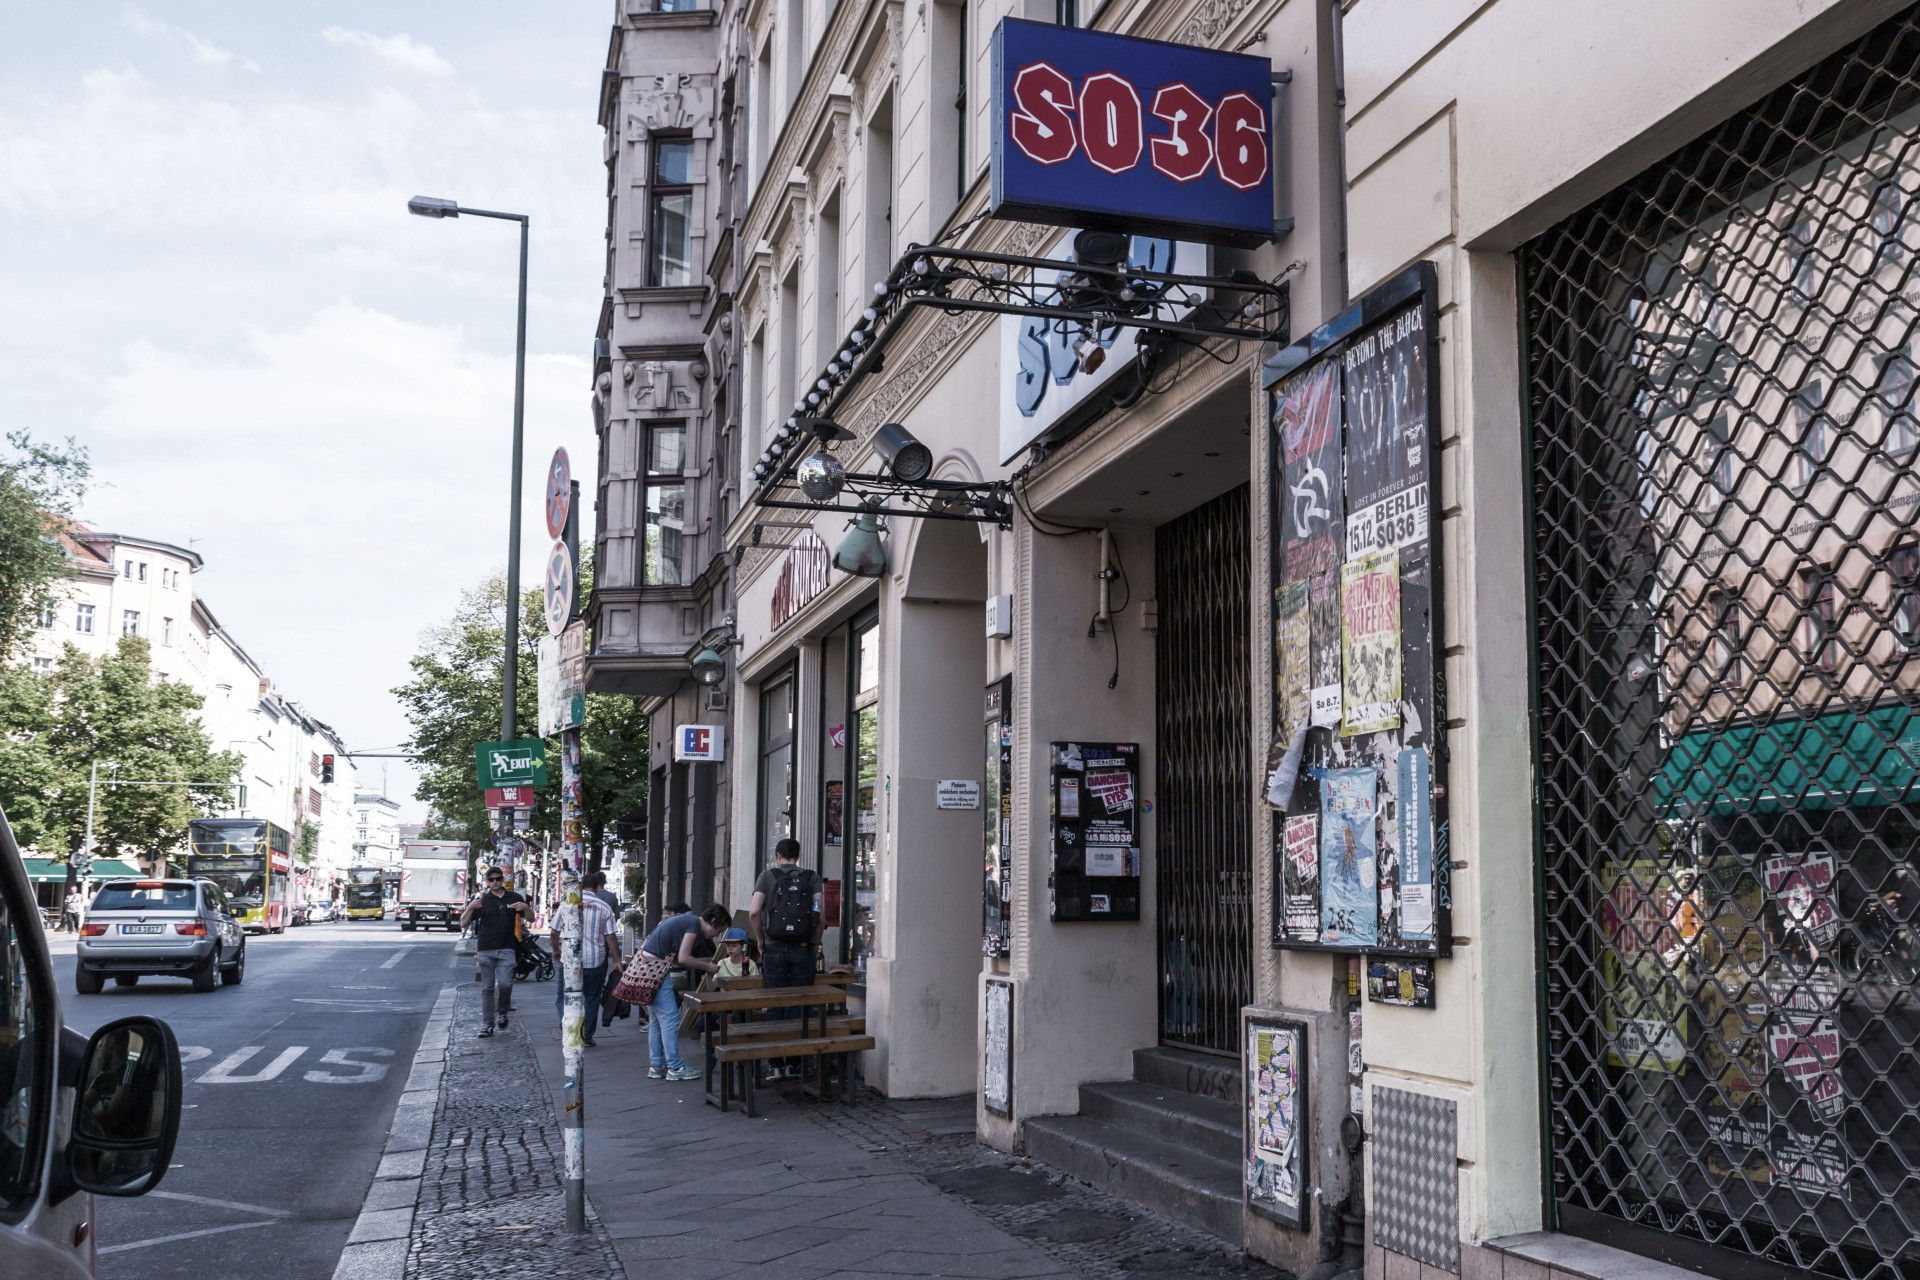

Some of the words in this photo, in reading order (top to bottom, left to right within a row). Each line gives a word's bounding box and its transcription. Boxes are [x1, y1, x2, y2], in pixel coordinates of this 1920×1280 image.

[1346, 335, 1375, 373] BEYOND
[1378, 324, 1394, 354] THE
[1396, 304, 1423, 342] BLACK
[1354, 495, 1367, 509] LOST
[1370, 492, 1377, 502] IN
[1378, 479, 1405, 498] FOREVER
[1408, 471, 1423, 485] 2017
[1375, 485, 1427, 523] BERLIN
[1349, 519, 1375, 554] 15.12.
[1376, 511, 1415, 550] SO36
[1351, 601, 1396, 638] QUEERS
[1316, 700, 1325, 709] Sa
[1326, 696, 1340, 707] 8.7.
[685, 728, 710, 752] EC
[510, 758, 531, 769] EXIT
[1087, 773, 1129, 787] DANCING
[1105, 790, 1129, 806] EYES
[1108, 833, 1132, 842] SO36
